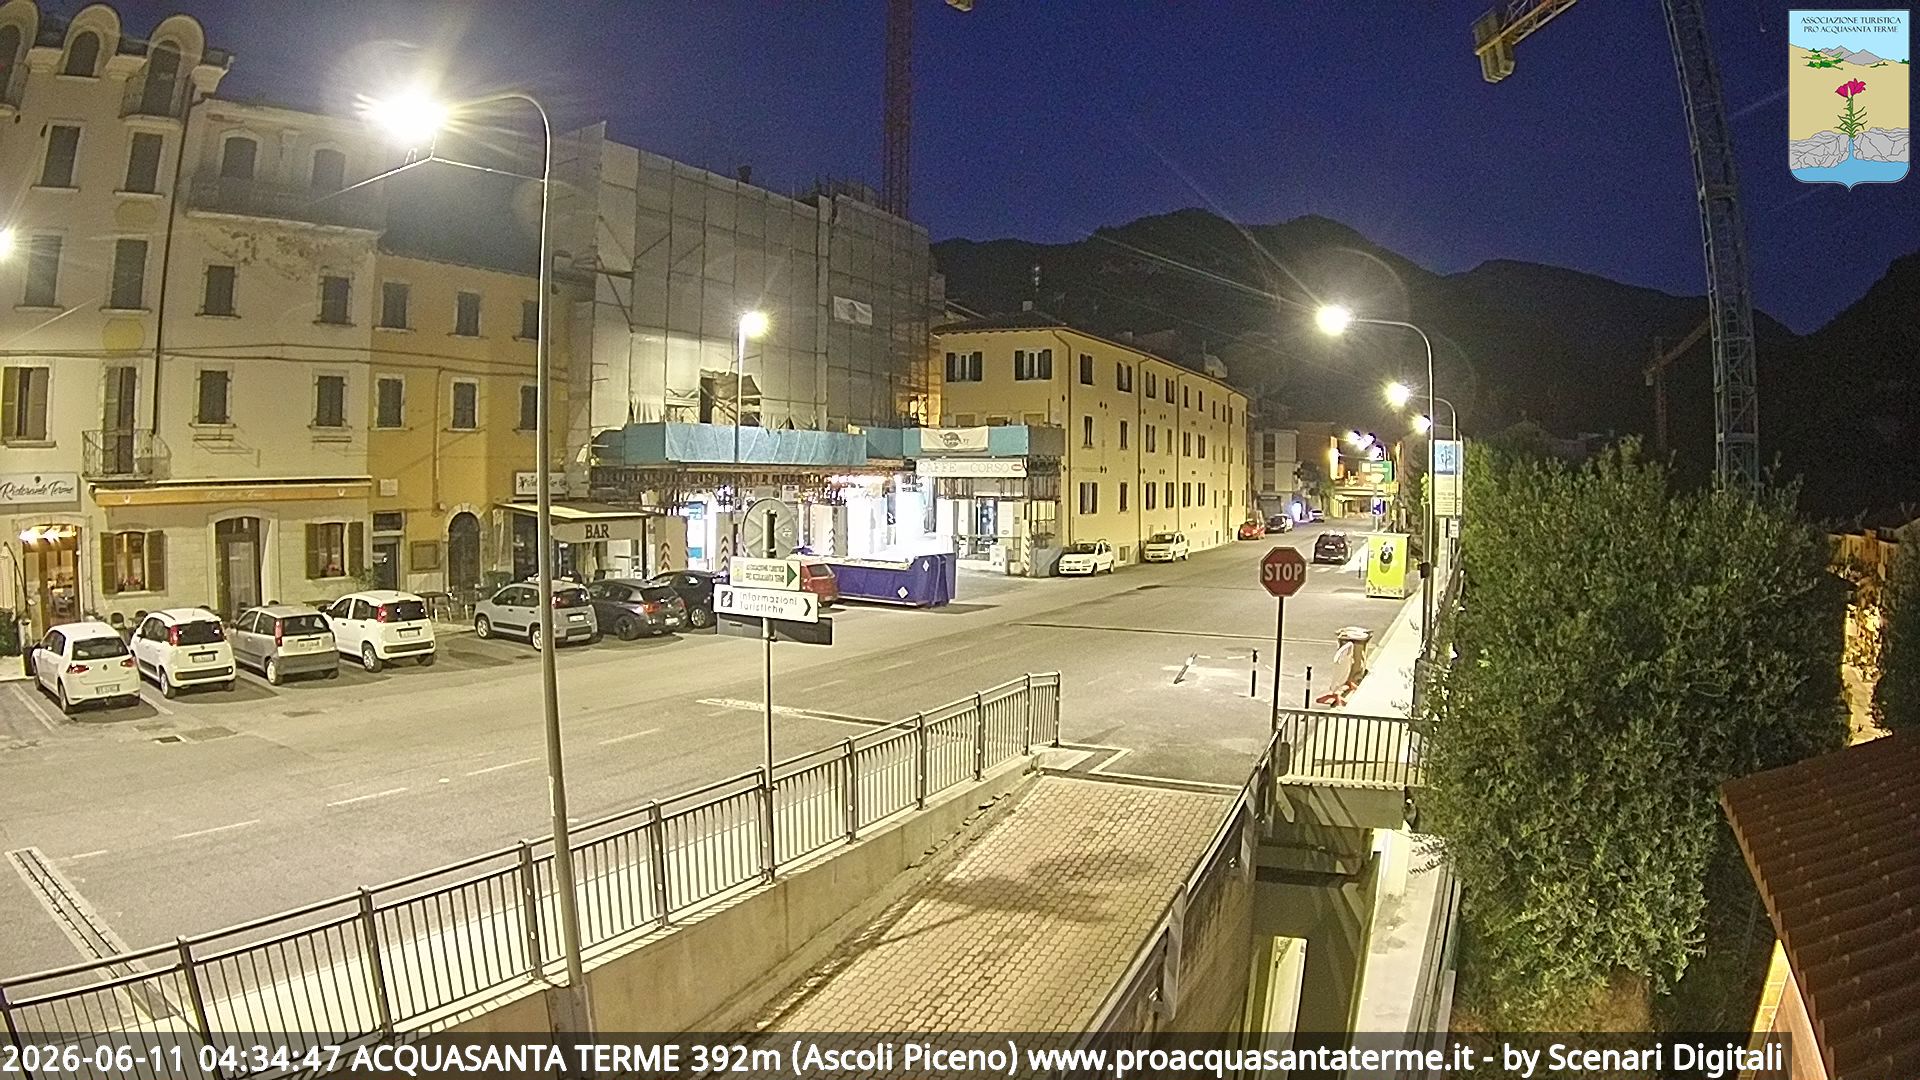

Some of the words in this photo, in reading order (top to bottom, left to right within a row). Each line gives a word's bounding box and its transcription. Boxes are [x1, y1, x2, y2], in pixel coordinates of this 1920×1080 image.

[970, 462, 1010, 473] CORSO
[585, 523, 610, 539] BAR
[1264, 562, 1303, 582] STOP
